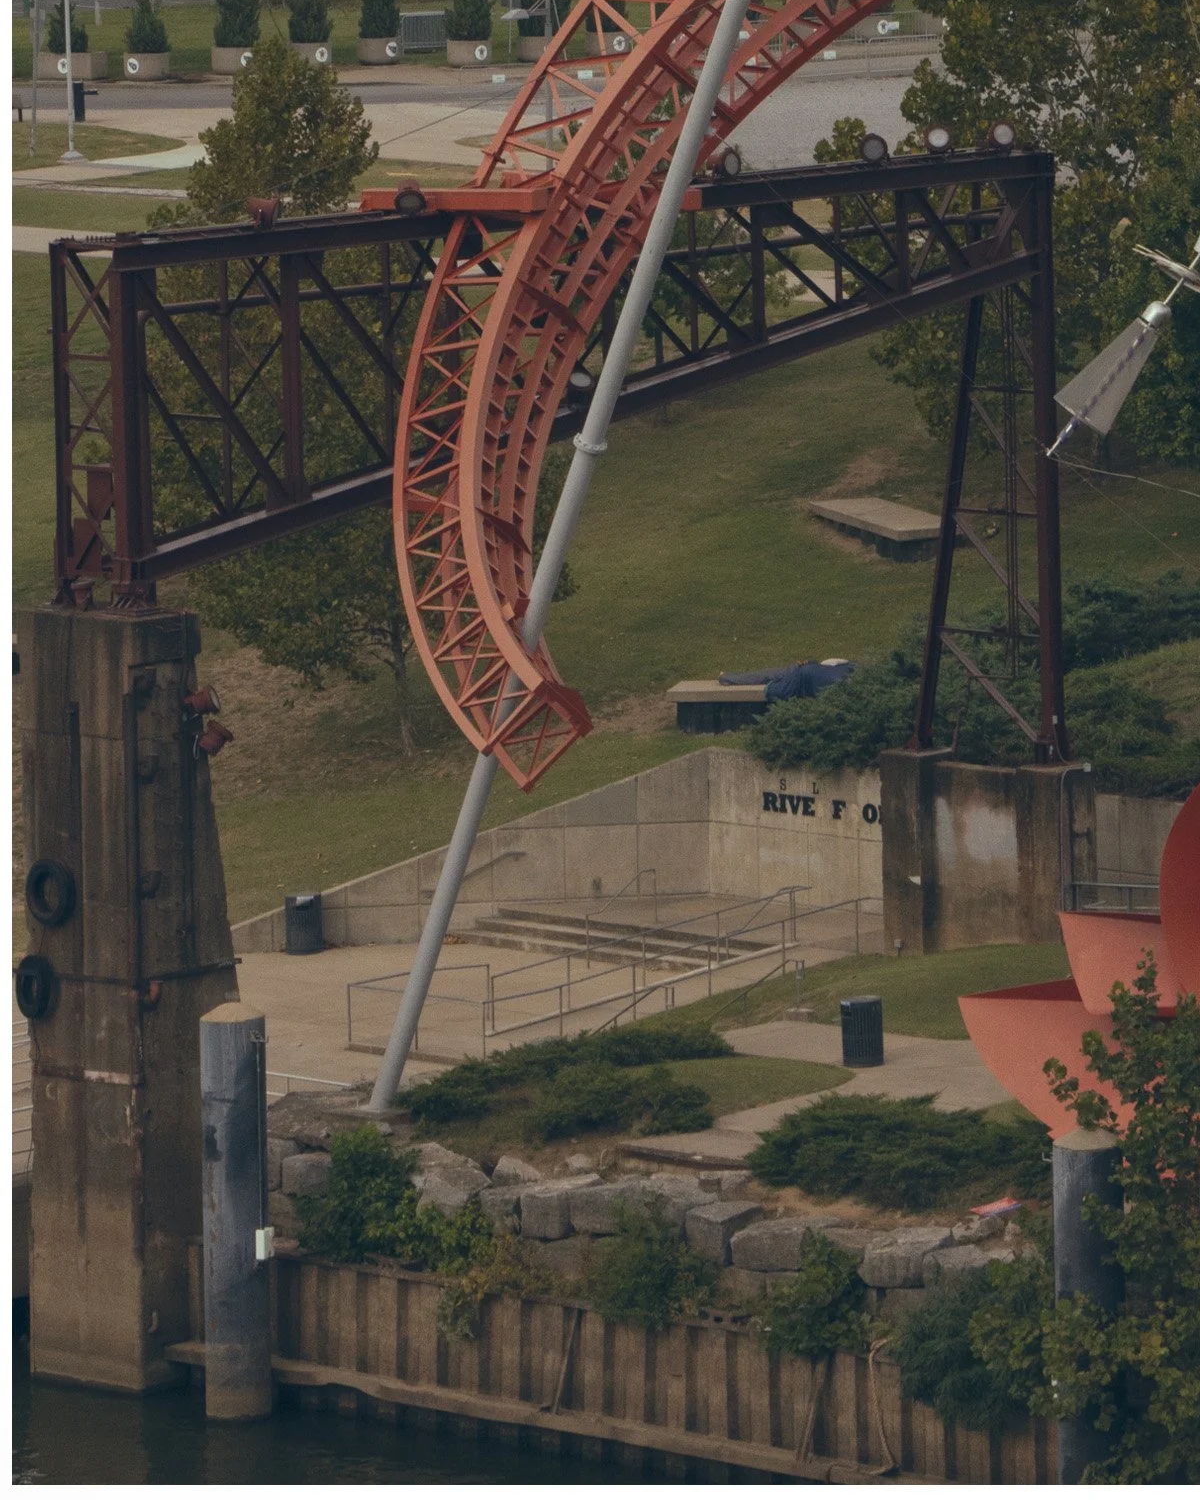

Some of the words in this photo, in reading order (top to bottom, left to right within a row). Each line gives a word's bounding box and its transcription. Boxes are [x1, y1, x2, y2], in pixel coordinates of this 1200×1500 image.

[780, 779, 787, 791] S
[812, 782, 820, 794] L
[762, 791, 816, 817] RIVE
[832, 799, 847, 820] F
